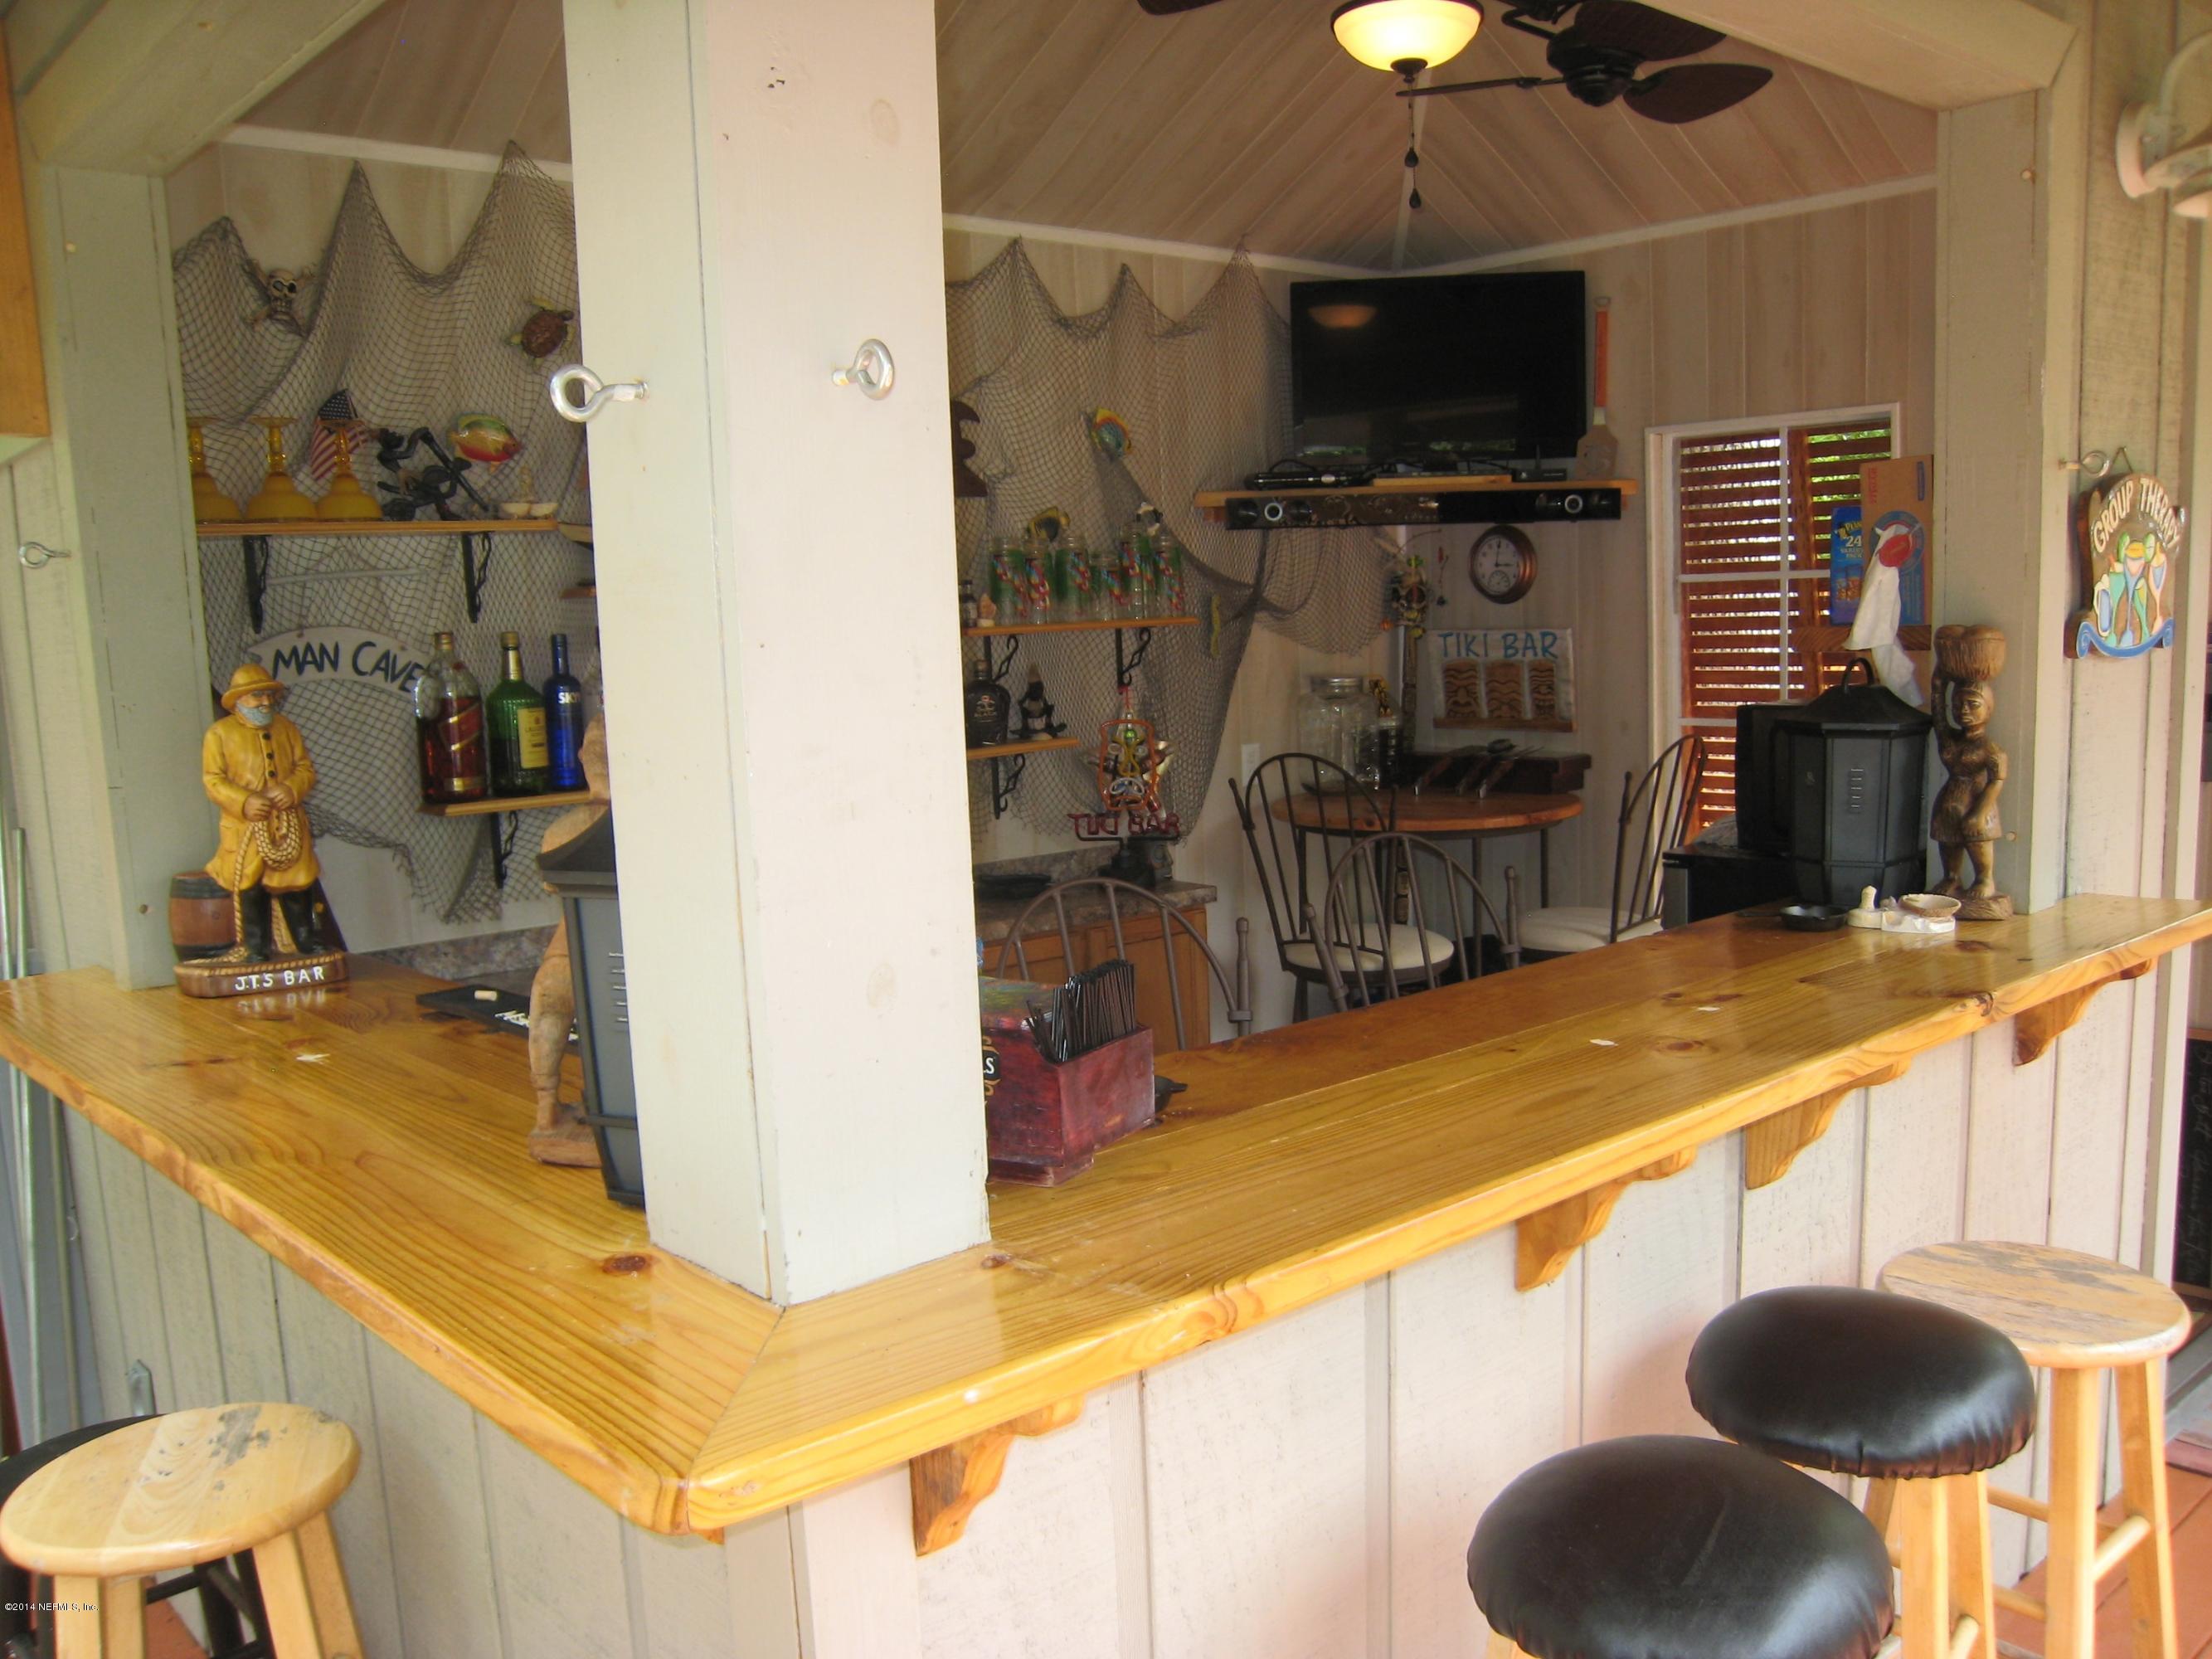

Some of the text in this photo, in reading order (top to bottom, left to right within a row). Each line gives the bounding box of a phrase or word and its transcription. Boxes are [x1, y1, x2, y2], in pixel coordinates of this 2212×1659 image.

[2093, 478, 2180, 552] GROUP THERAPY
[1845, 535, 1862, 547] 24
[1438, 630, 1558, 659] TIKI BAR
[272, 641, 425, 693] MAN CAVE
[1129, 812, 1179, 835] BAR
[284, 966, 324, 985] BAR
